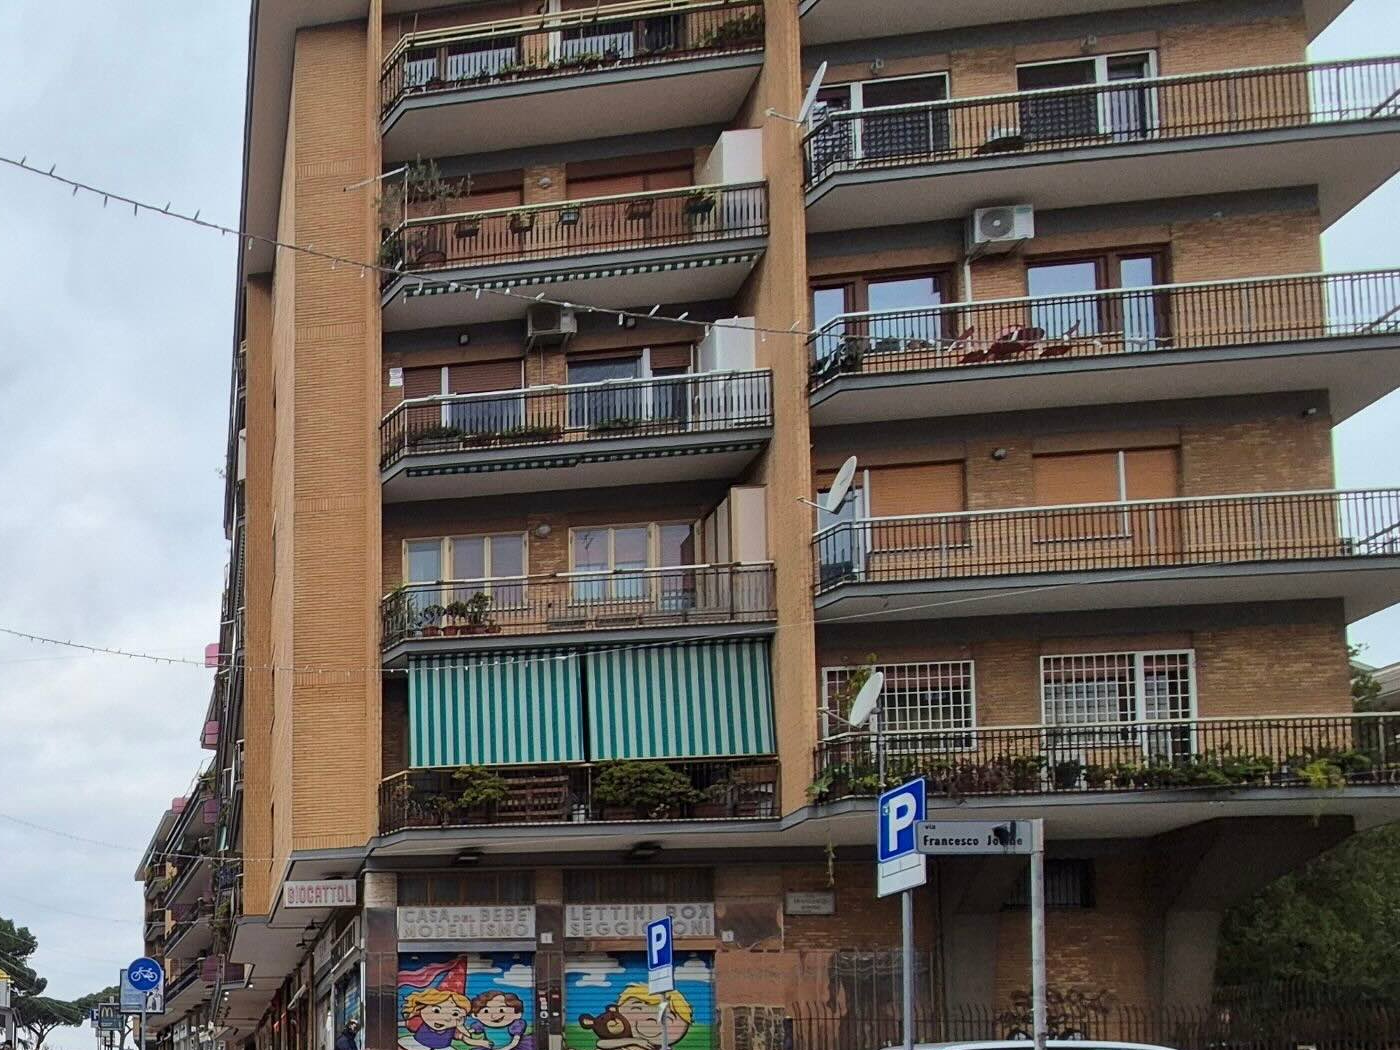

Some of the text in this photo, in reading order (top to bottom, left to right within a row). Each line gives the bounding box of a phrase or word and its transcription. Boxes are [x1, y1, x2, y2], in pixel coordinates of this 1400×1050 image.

[888, 792, 916, 852] P
[923, 834, 980, 847] Francesco
[403, 909, 449, 923] CASA
[569, 905, 710, 921] LETTINI BOX
[404, 924, 530, 938] MODELLISMO
[652, 924, 668, 965] P
